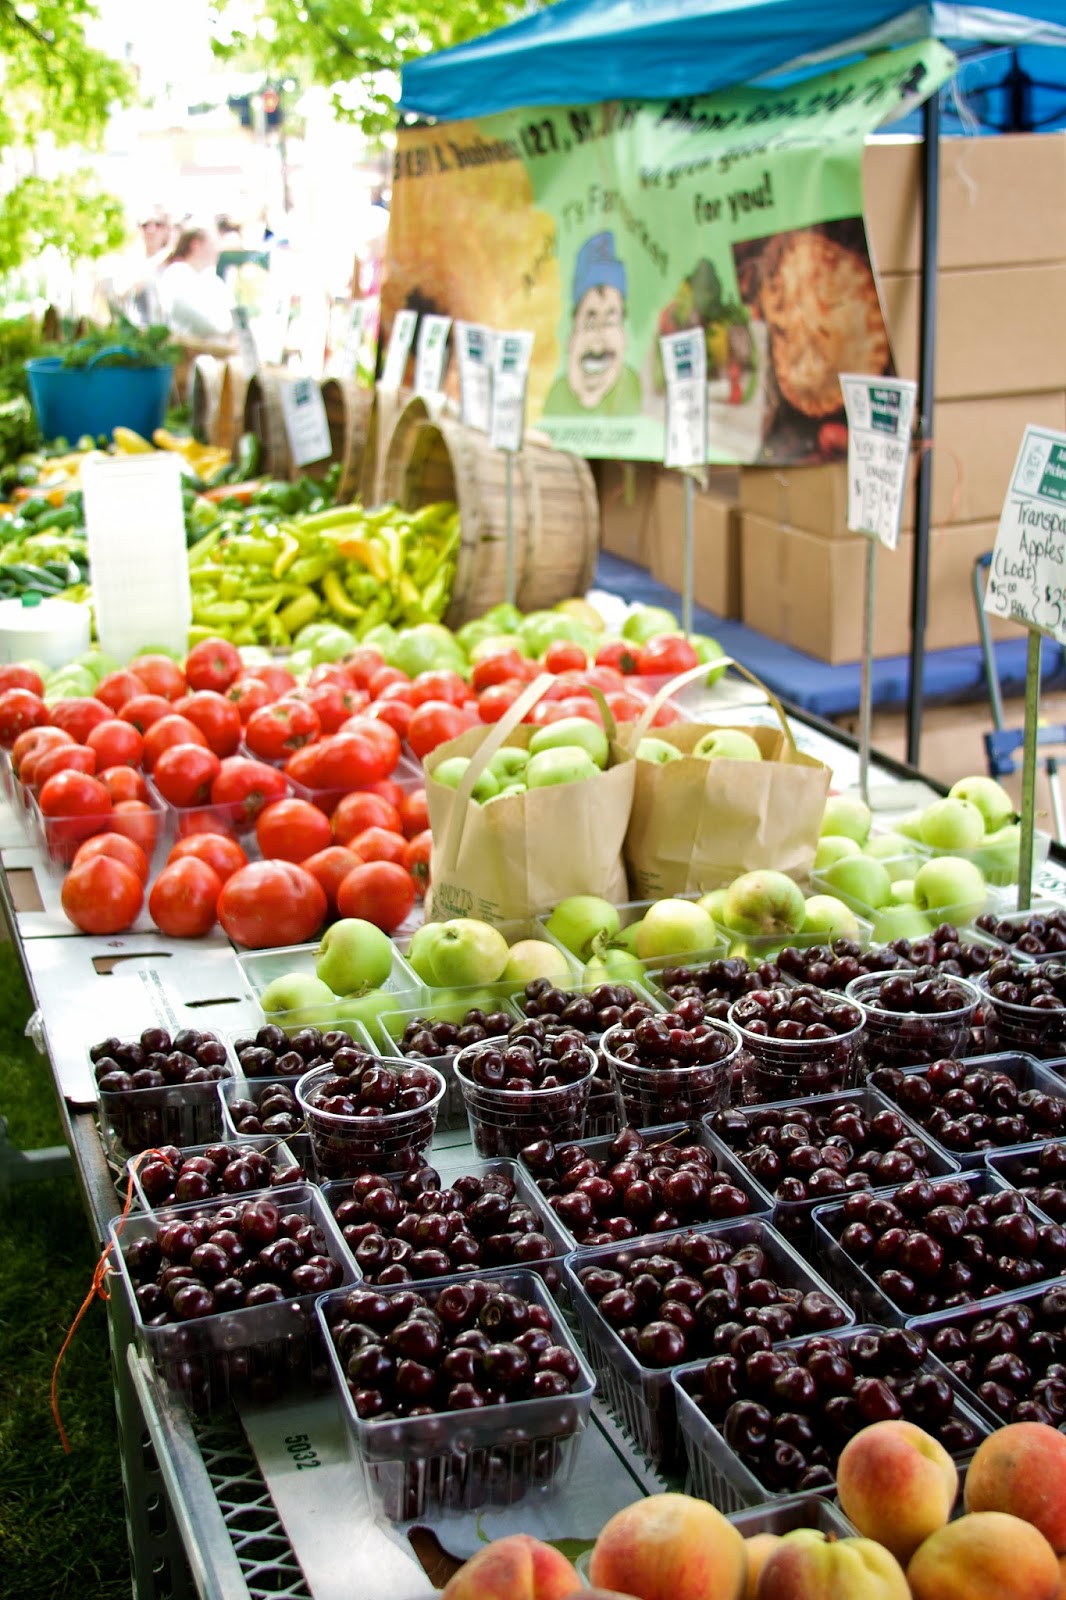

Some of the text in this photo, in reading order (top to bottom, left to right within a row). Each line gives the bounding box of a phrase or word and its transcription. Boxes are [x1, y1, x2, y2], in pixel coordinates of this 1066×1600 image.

[693, 170, 774, 226] for you!
[1018, 530, 1064, 566] Apples
[284, 1433, 321, 1470] 5032
